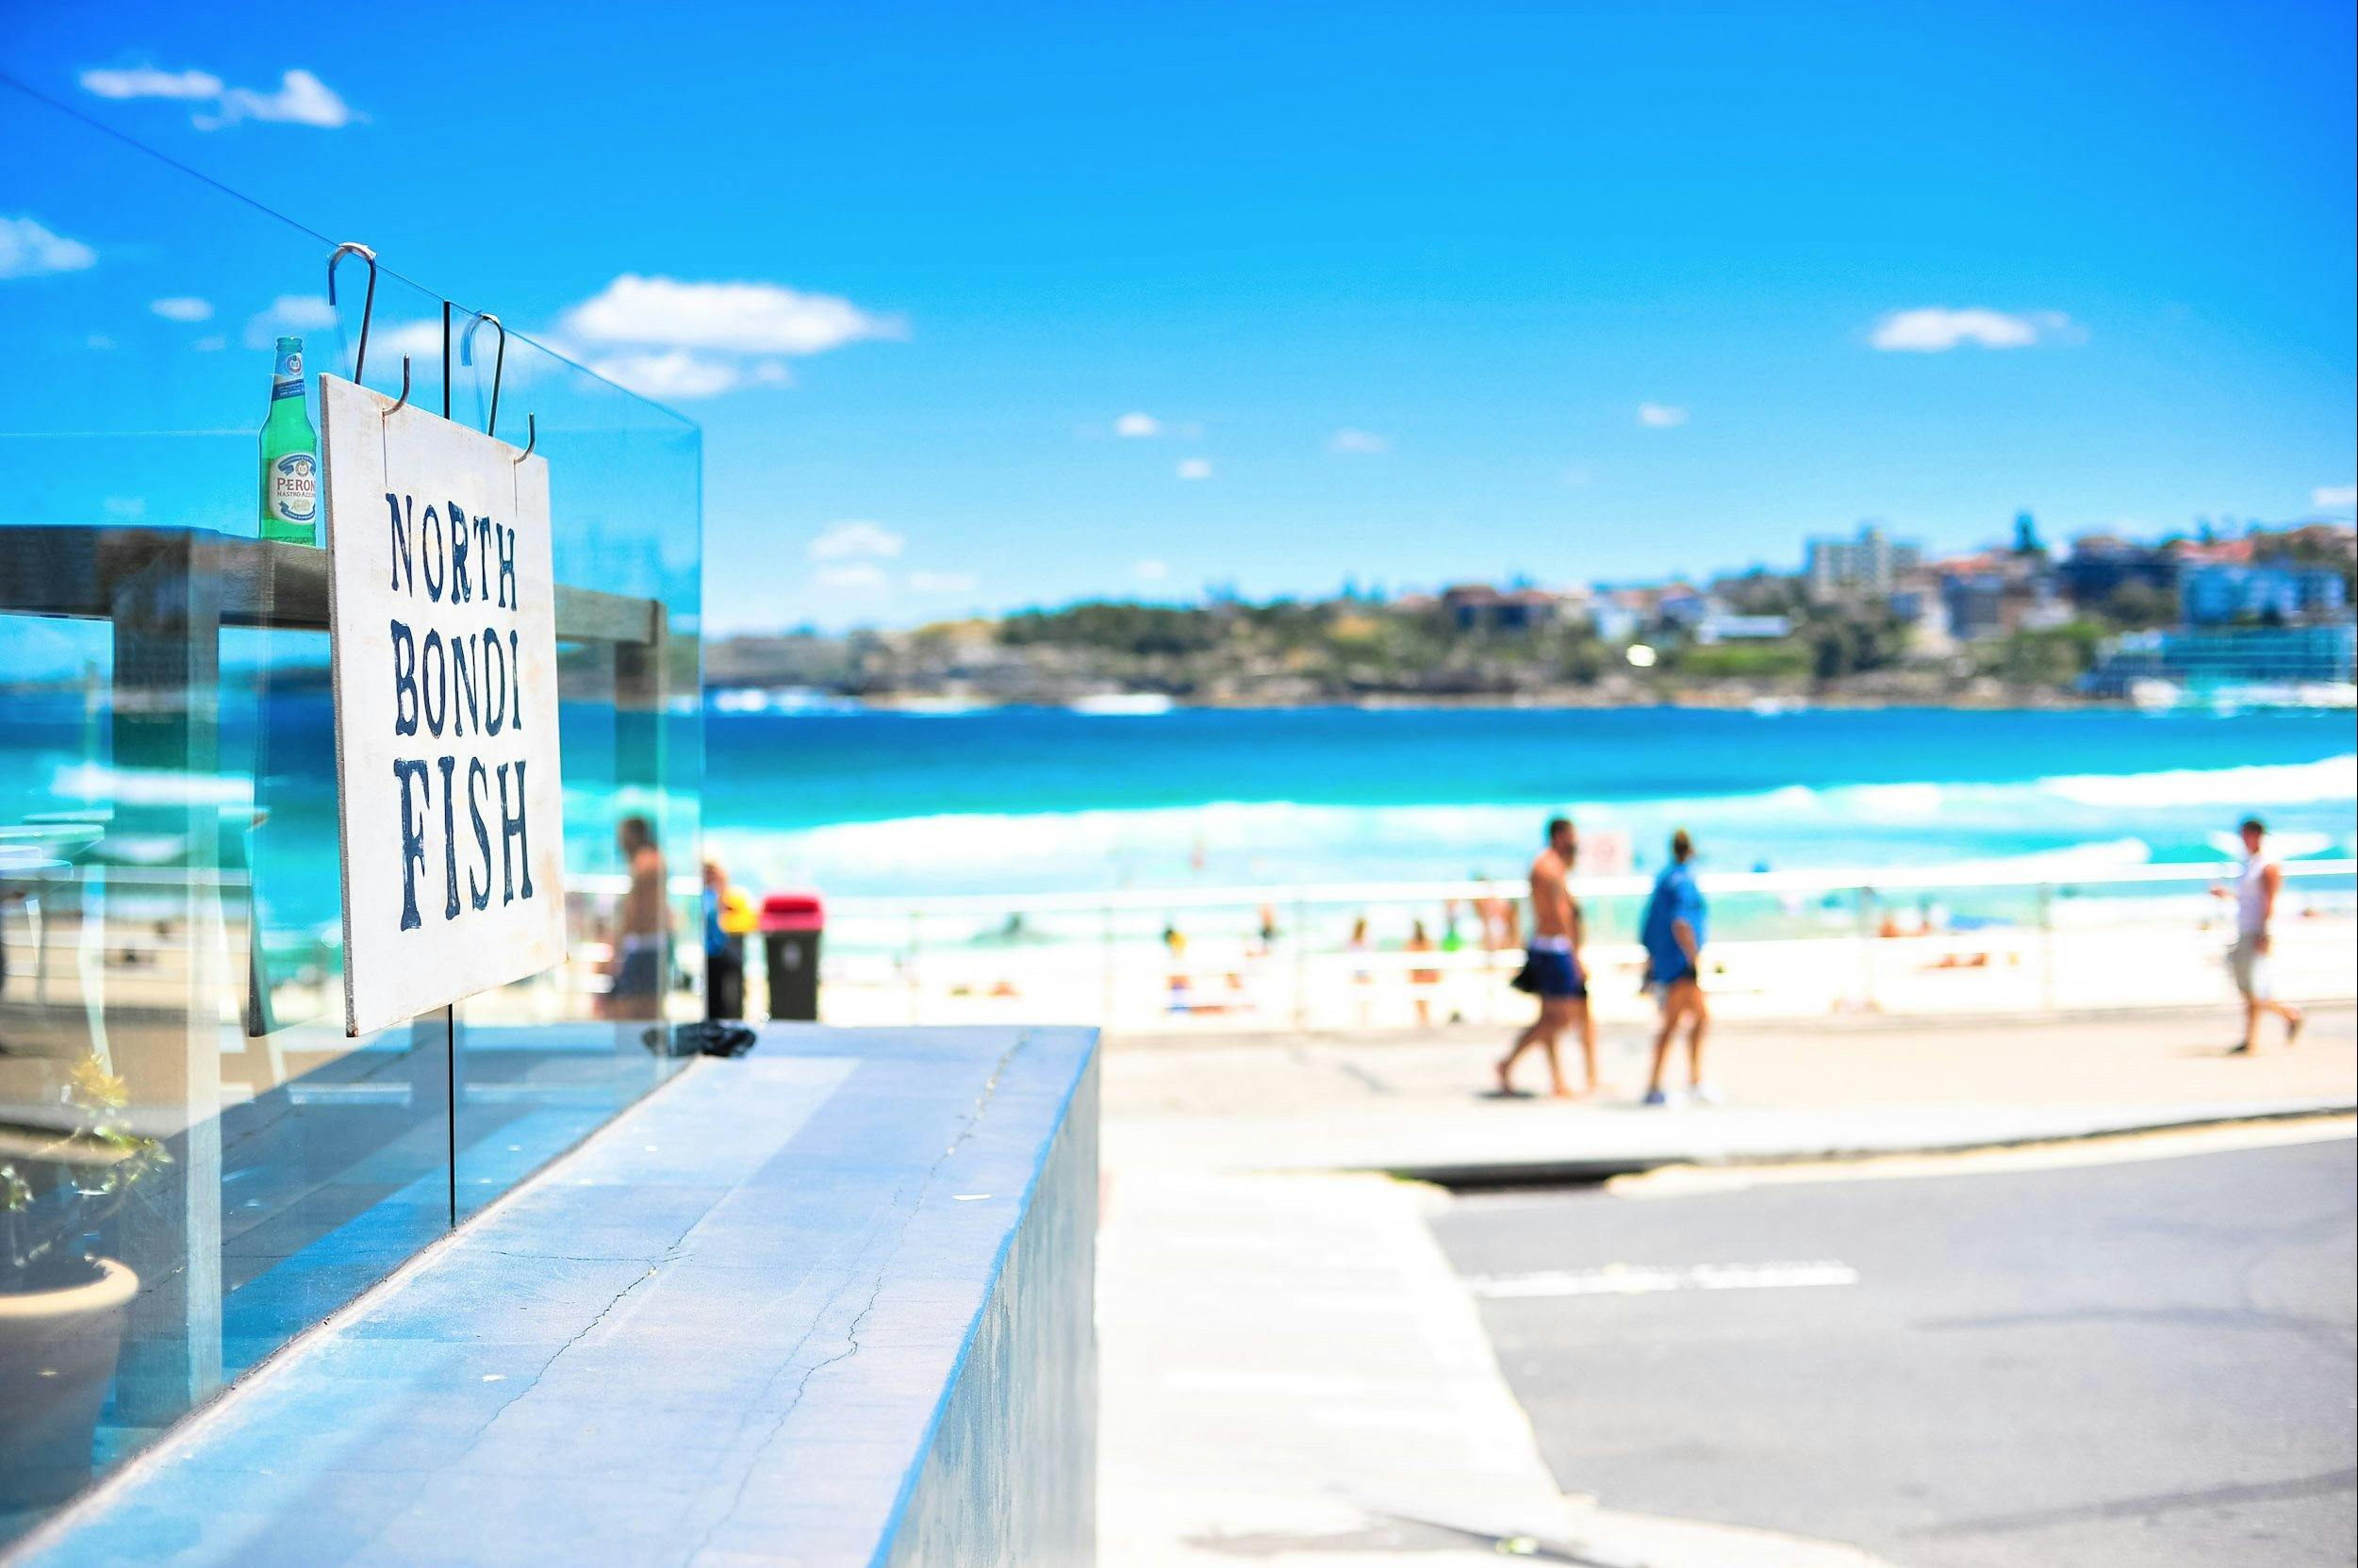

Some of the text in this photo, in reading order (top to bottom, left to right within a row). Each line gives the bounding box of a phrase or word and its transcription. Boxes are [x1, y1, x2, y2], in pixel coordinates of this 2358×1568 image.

[385, 492, 518, 612] NORTH
[390, 619, 521, 739] BONDI
[393, 755, 534, 933] FISH
